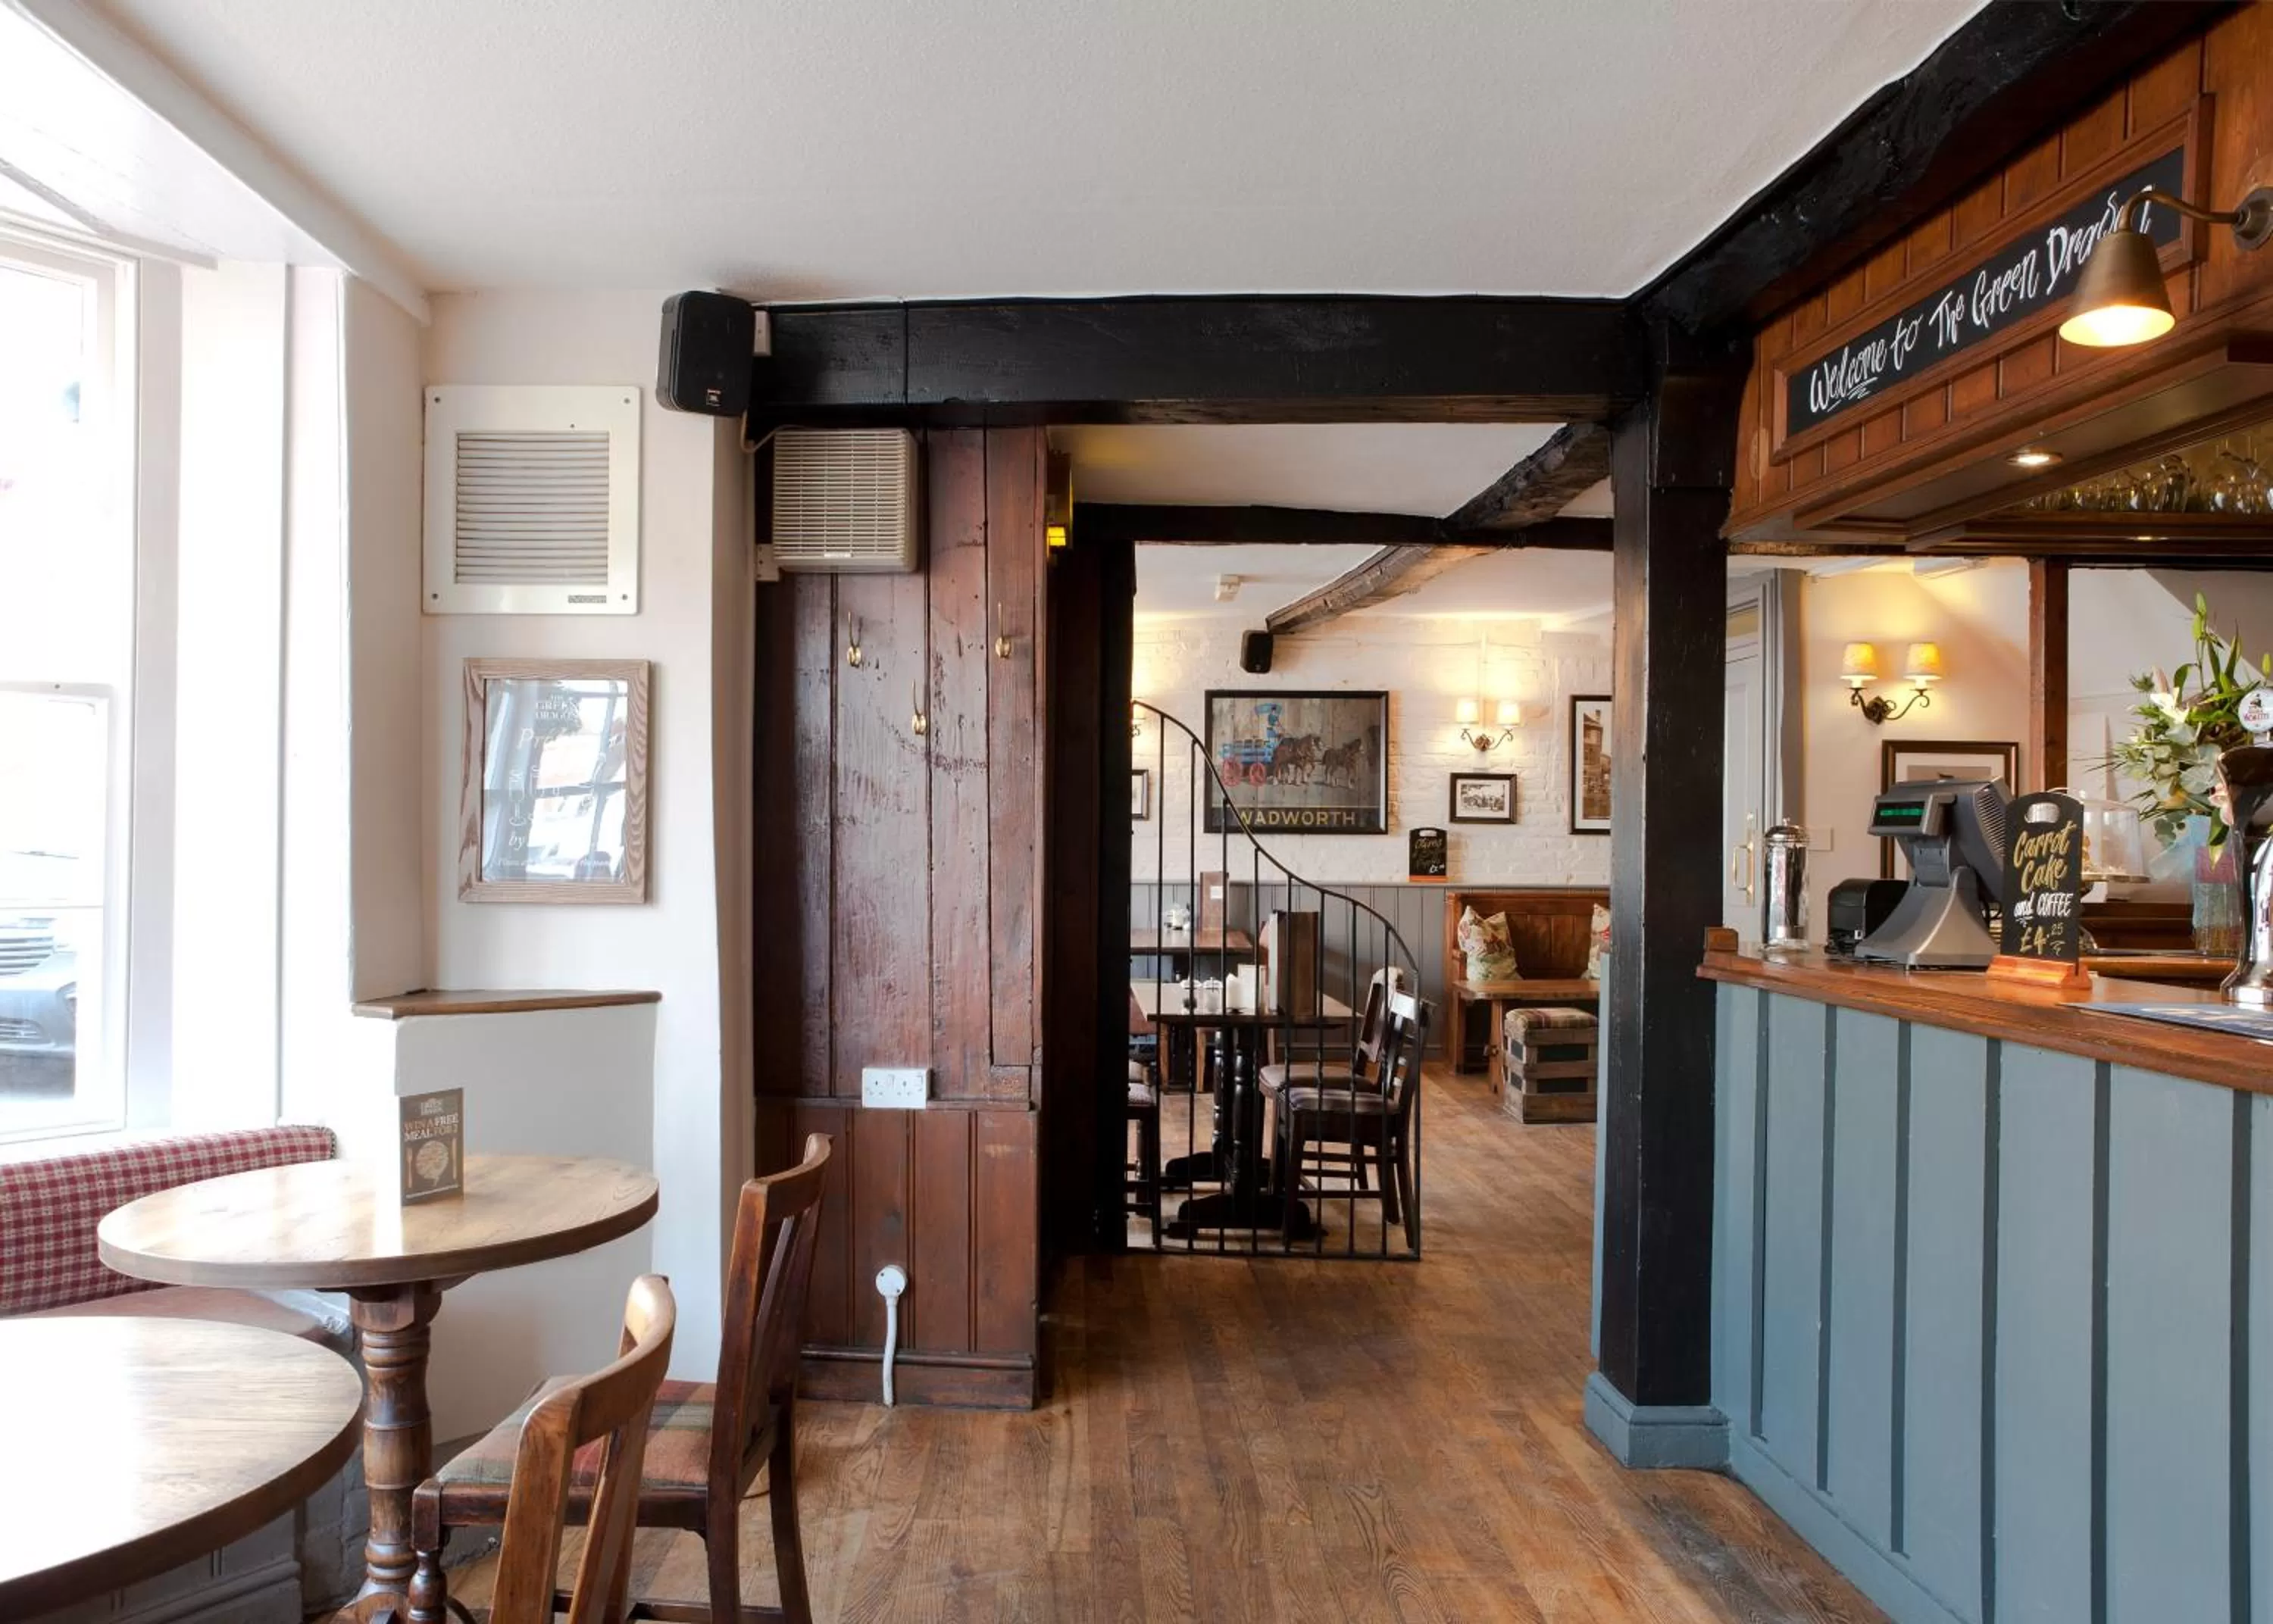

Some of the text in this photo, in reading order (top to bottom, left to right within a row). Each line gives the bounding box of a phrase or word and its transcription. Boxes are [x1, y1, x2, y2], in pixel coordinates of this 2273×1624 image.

[1810, 339, 1887, 413] Welcome
[1890, 314, 1924, 371] to
[1928, 290, 1965, 348] The
[1972, 249, 2040, 328] Green
[1238, 811, 1355, 826] WADWORTH
[2013, 820, 2078, 868] Carrot
[2021, 854, 2068, 894] Cake
[2013, 891, 2074, 917] and COFFEE
